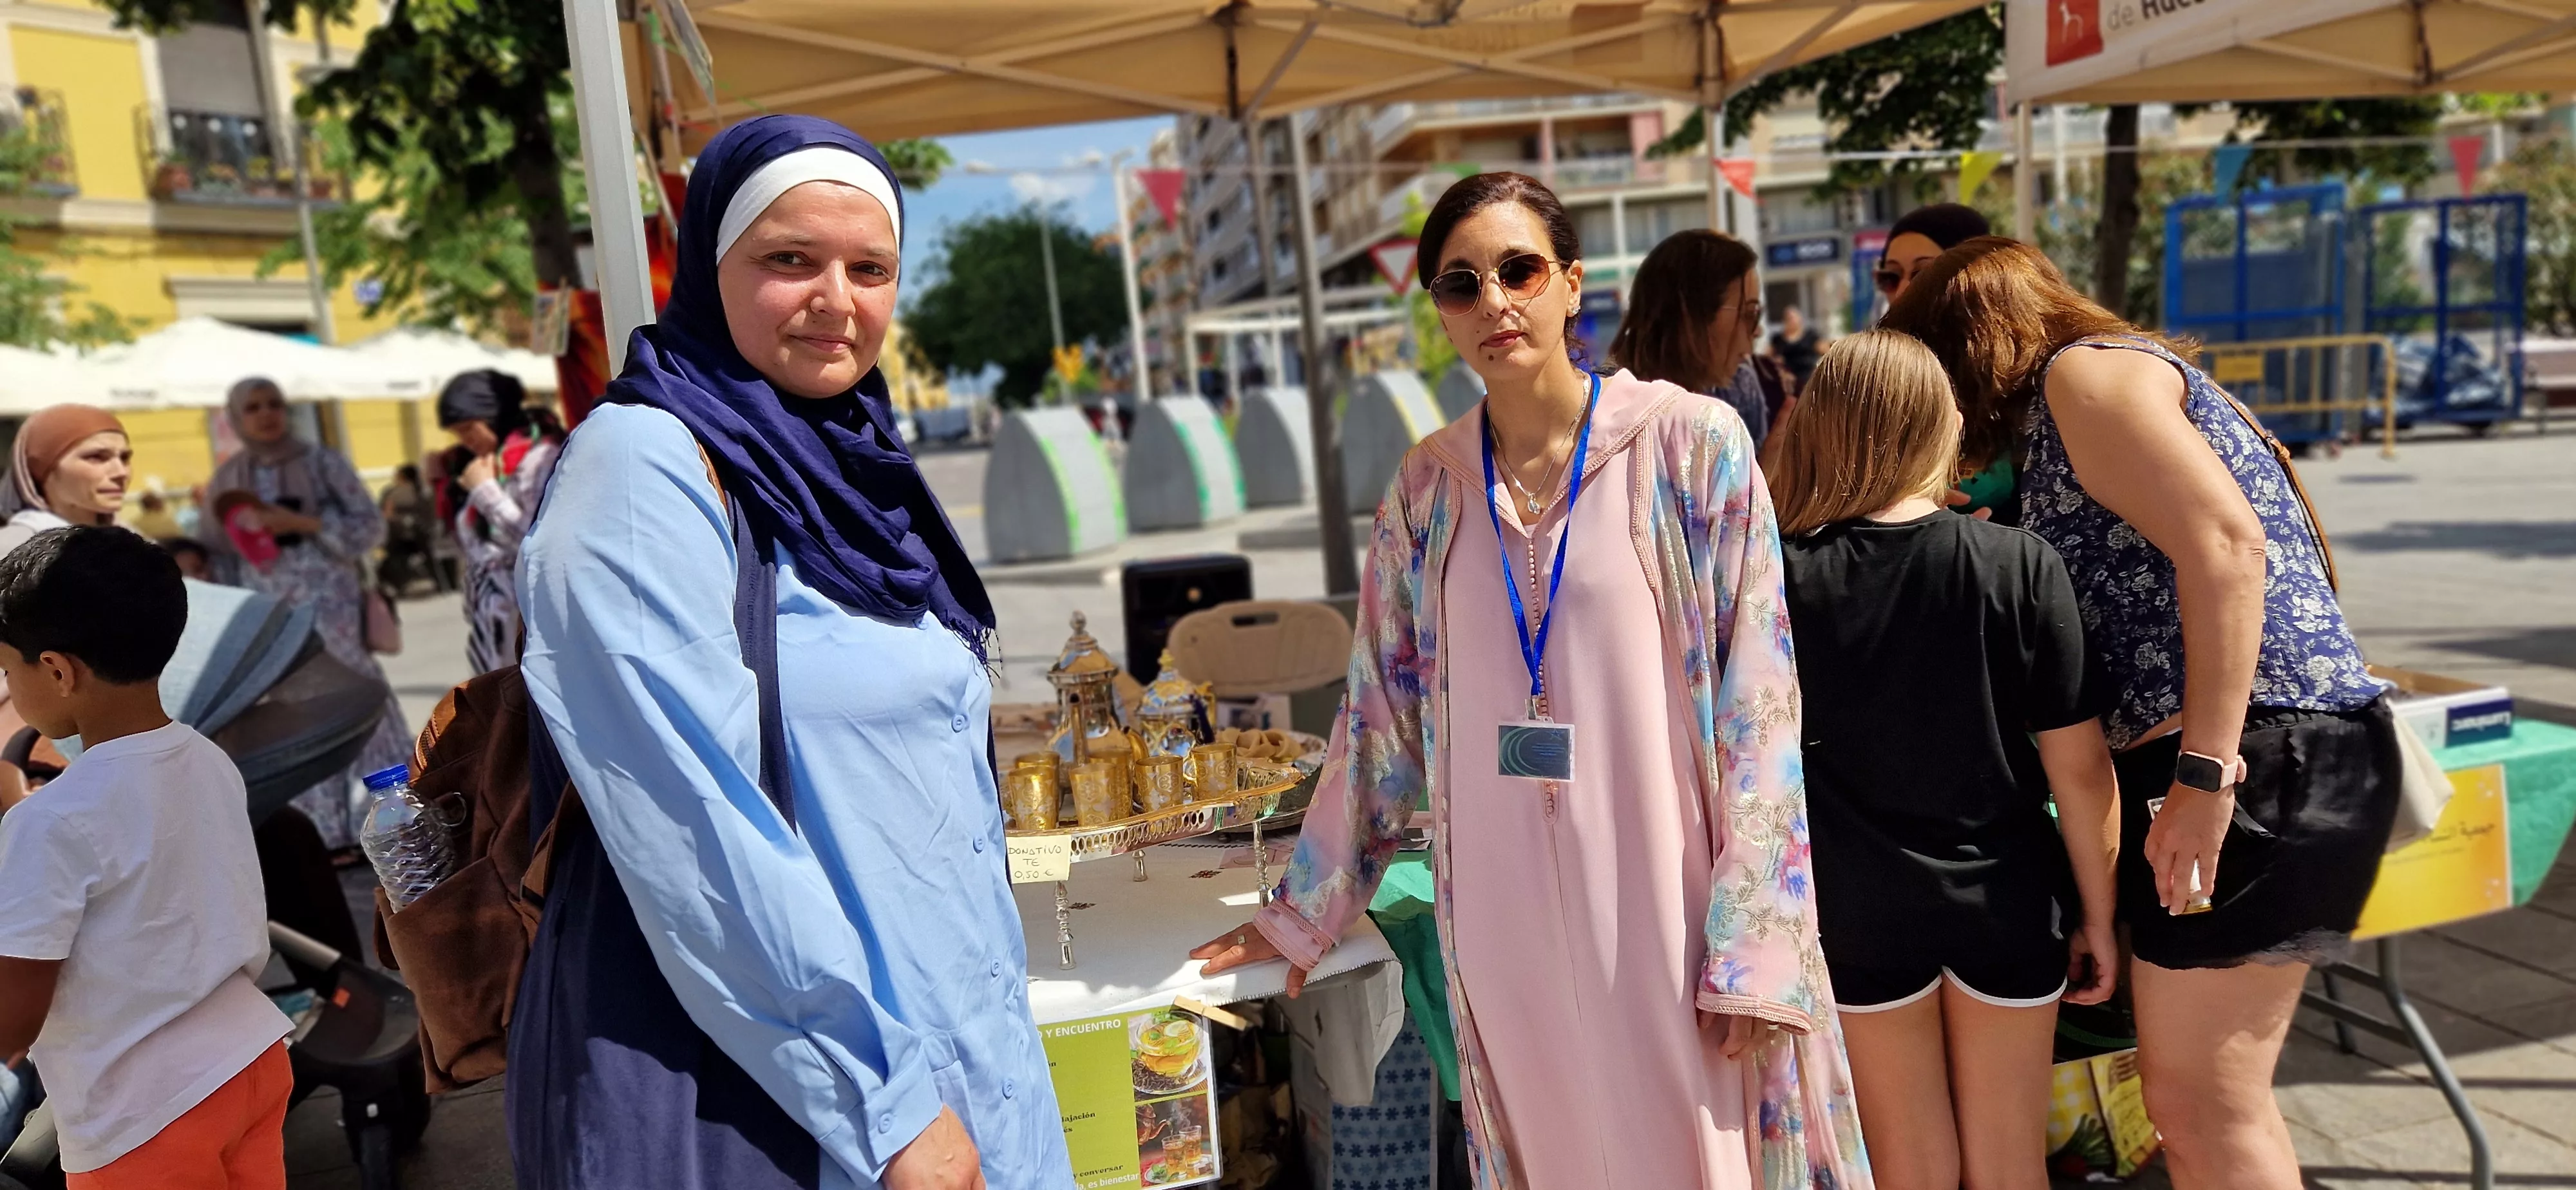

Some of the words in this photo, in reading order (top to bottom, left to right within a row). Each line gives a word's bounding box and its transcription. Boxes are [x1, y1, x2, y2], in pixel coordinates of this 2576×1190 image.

[2107, 3, 2135, 31] de
[1008, 845, 1061, 855] DONATIVO
[1023, 858, 1040, 867] TE
[1014, 871, 1039, 880] 0,50
[1046, 1030, 1052, 1039] Y
[1056, 1019, 1121, 1037] ENCUENTRO
[1079, 1165, 1124, 1177] conversar
[1088, 1180, 1098, 1189] es
[1099, 1173, 1139, 1187] bienestar
